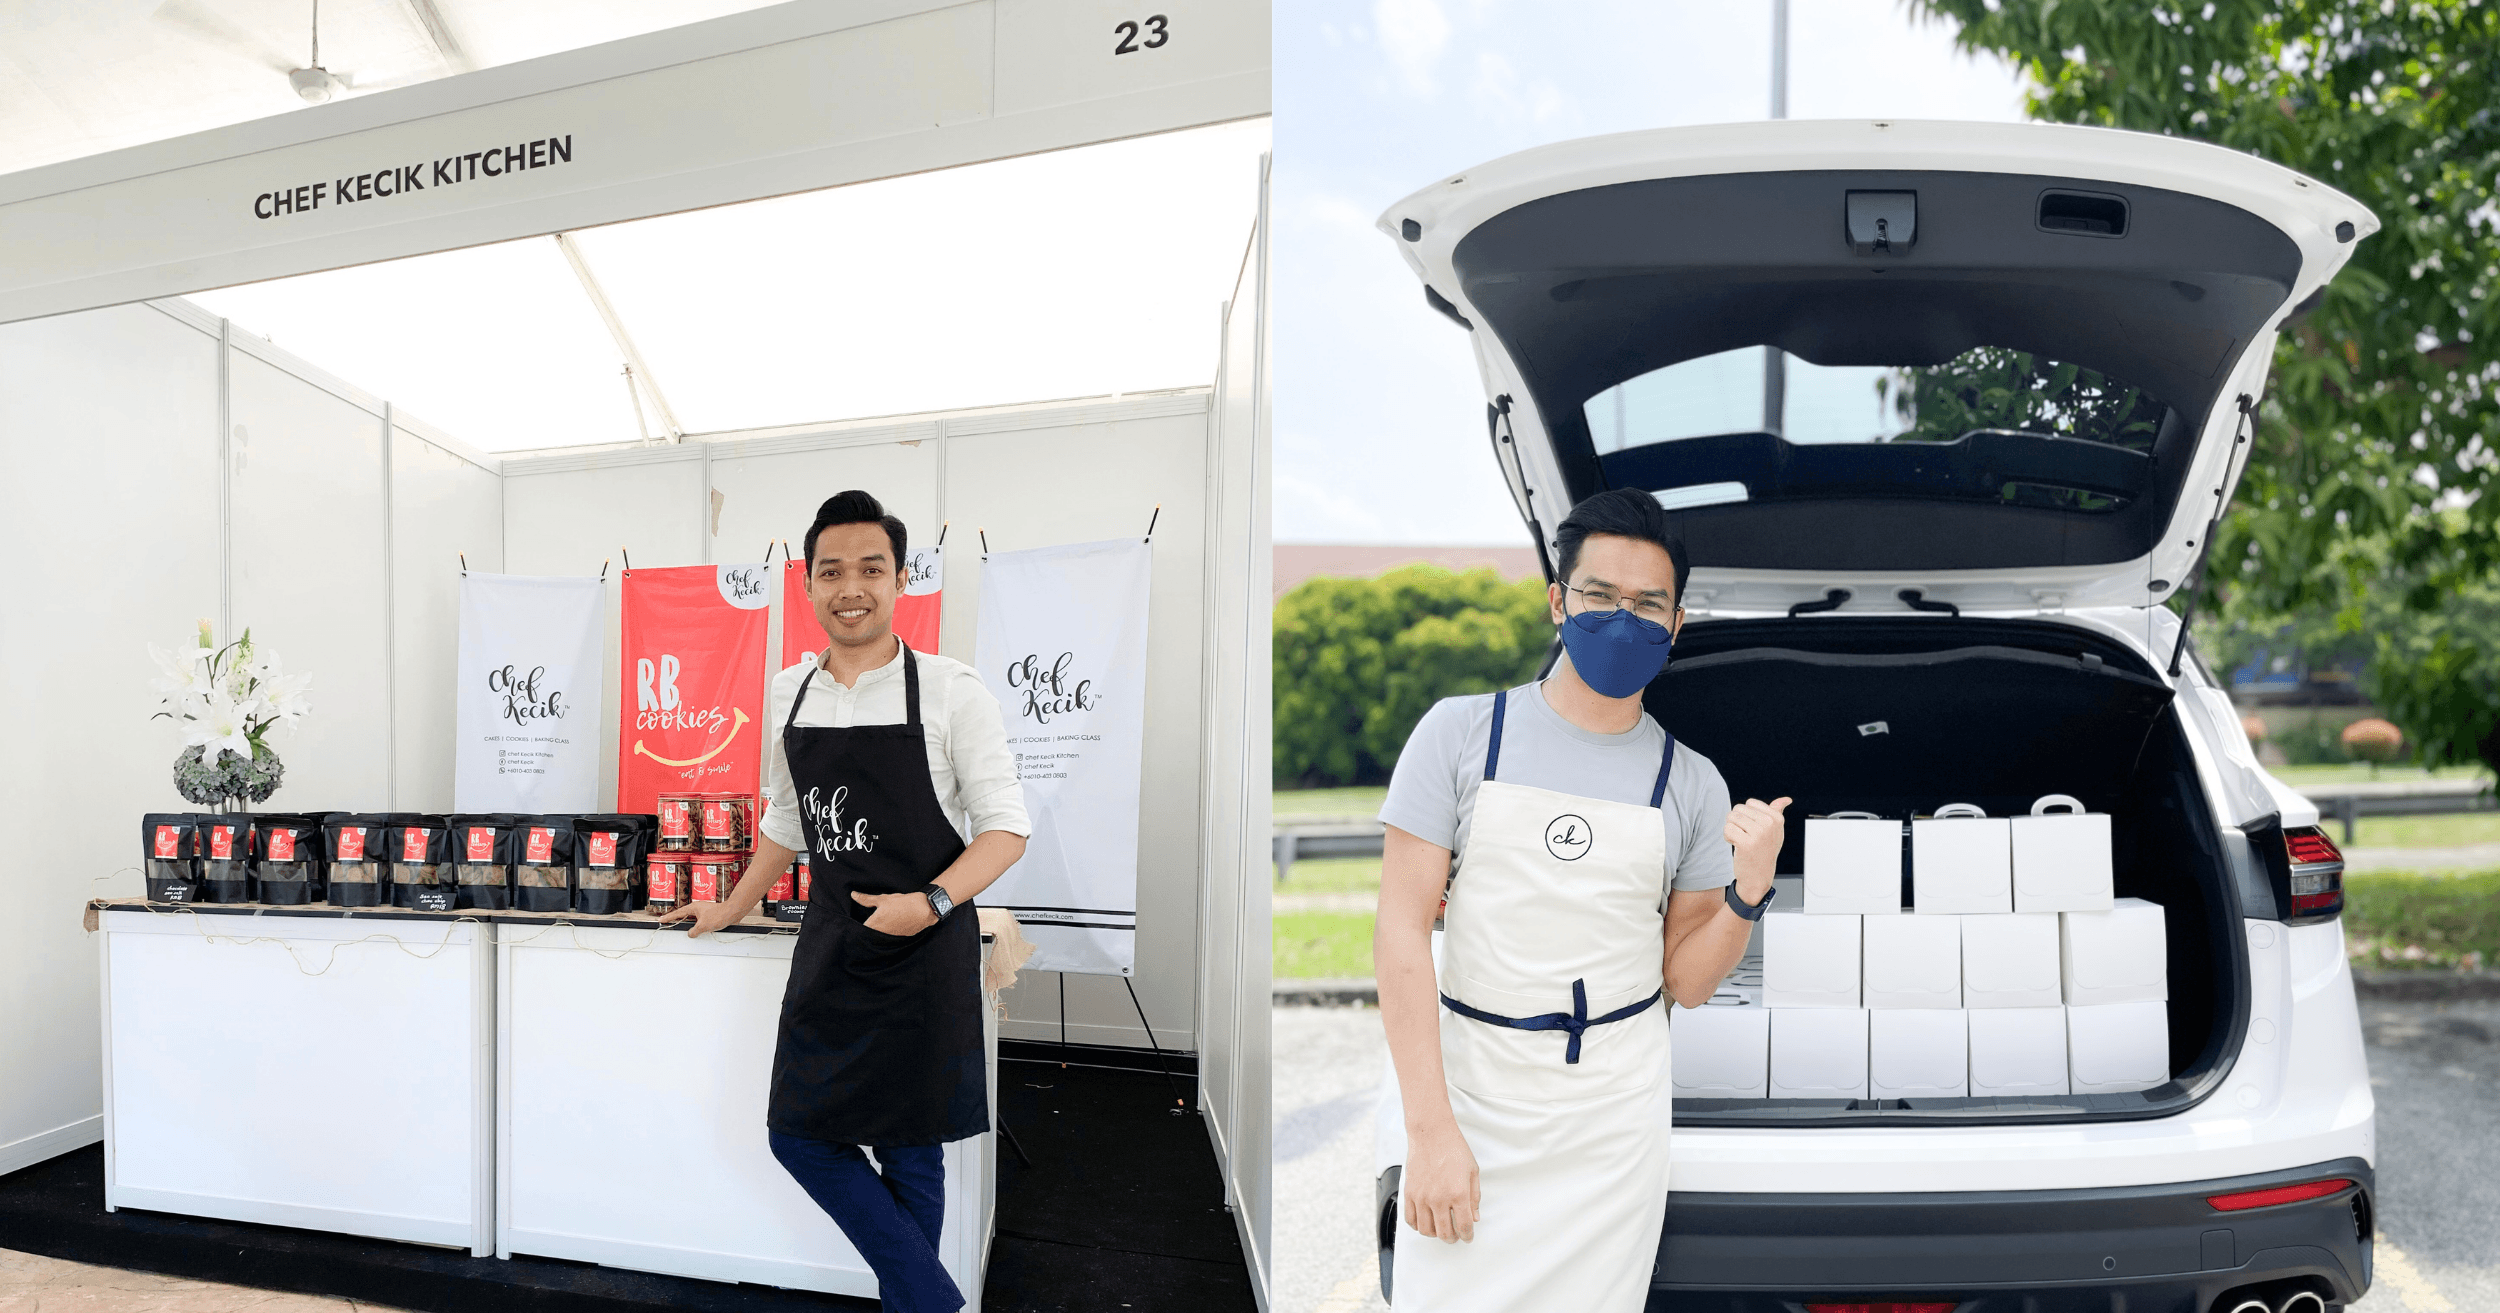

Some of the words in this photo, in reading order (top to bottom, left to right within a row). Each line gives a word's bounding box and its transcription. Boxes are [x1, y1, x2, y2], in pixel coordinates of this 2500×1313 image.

[1114, 14, 1169, 56] 23
[254, 182, 326, 220] CHEF
[336, 163, 424, 205] KECIK
[434, 134, 572, 186] KITCHEN
[726, 569, 752, 588] Chef
[732, 581, 762, 600] Kecik
[489, 665, 544, 703] Chef
[637, 654, 680, 712] RB
[1008, 652, 1072, 696] Chef
[503, 692, 565, 726] Kecik
[636, 701, 729, 734] cookies
[1022, 680, 1094, 724] Kecik
[803, 786, 848, 833] Chef
[815, 818, 873, 862] Kecik
